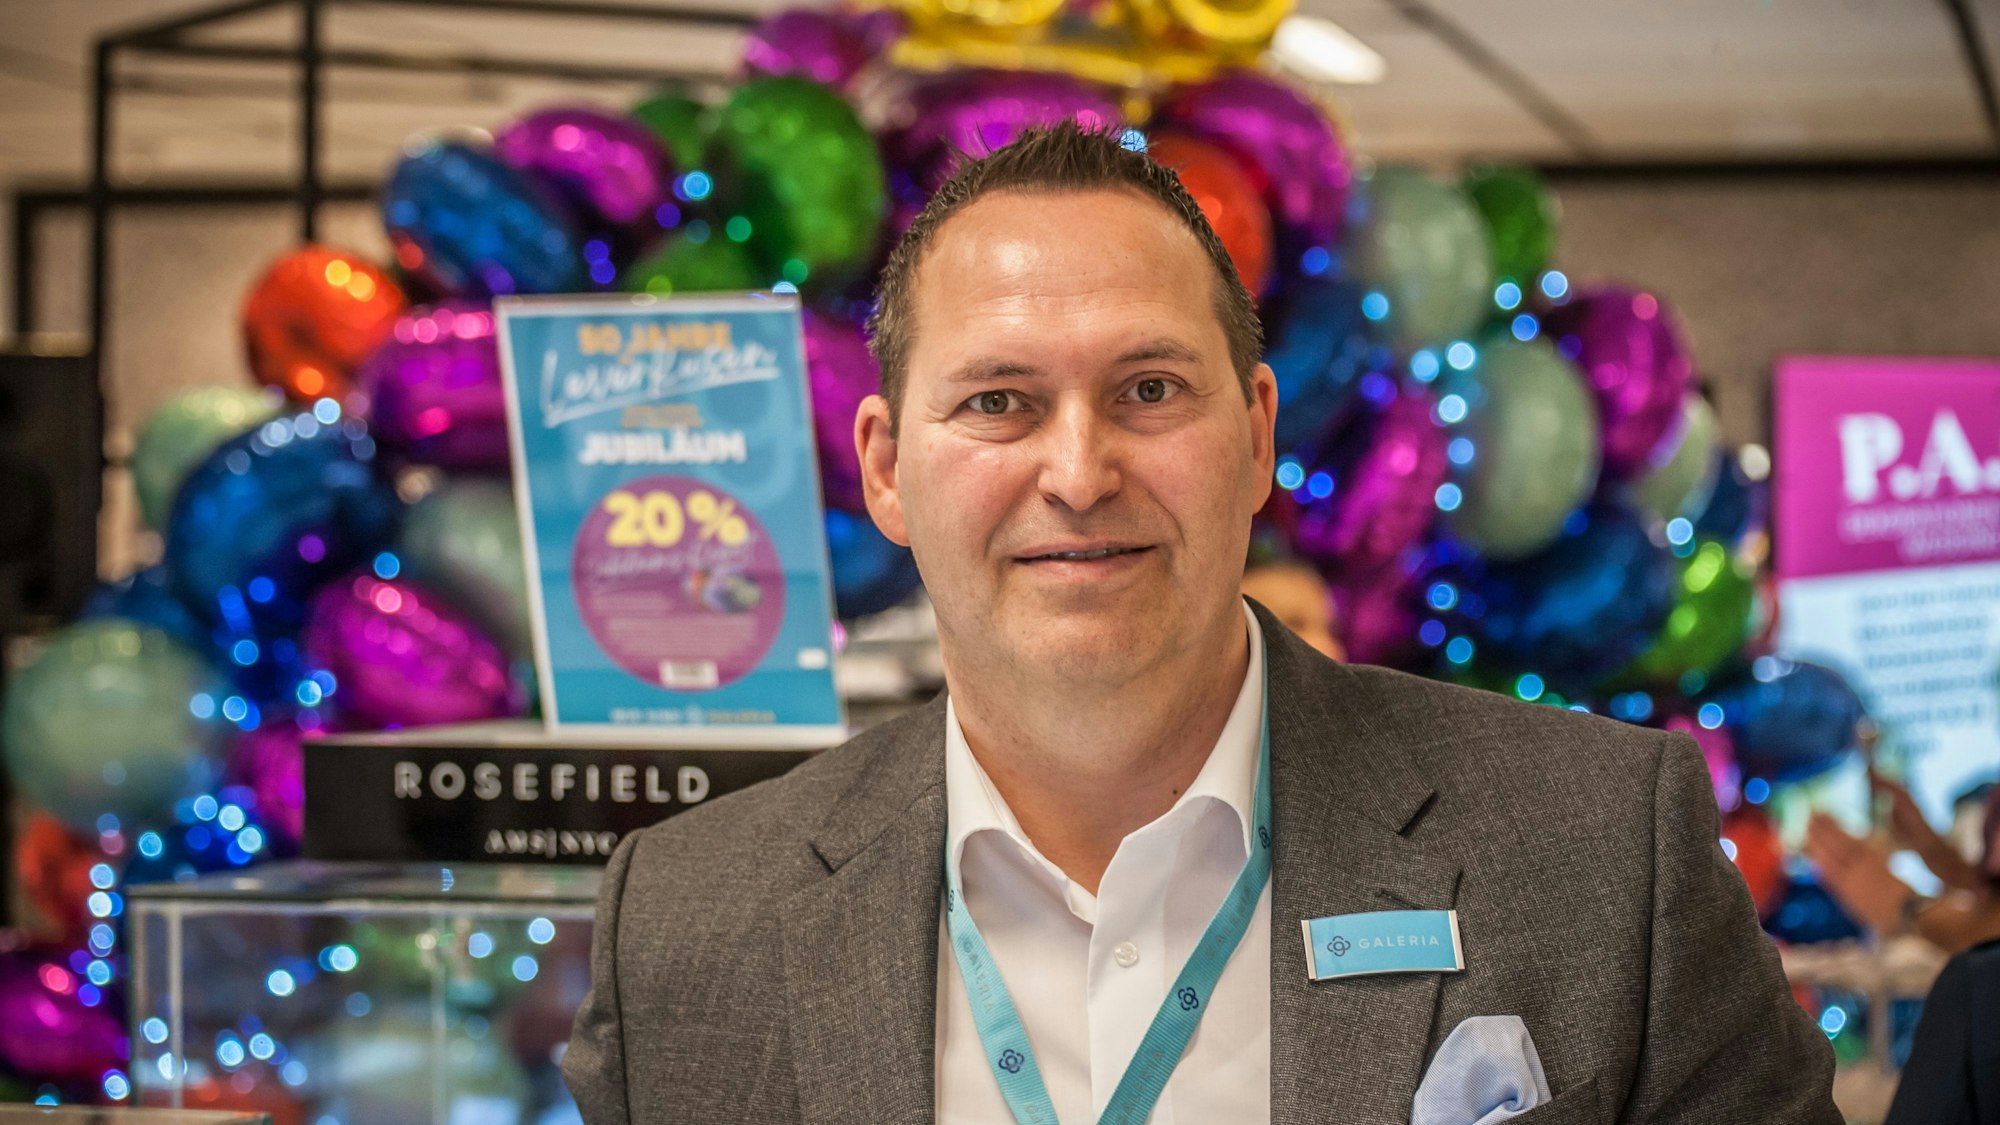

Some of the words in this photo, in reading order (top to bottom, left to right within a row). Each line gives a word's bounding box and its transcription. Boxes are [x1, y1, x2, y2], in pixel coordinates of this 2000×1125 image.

[578, 424, 749, 465] JUBILÄUM
[602, 489, 686, 548] 20
[686, 489, 751, 547] %
[393, 761, 711, 804] ROSEFIELD
[1357, 934, 1441, 950] GALERIA
[961, 938, 995, 1015] GALERIA
